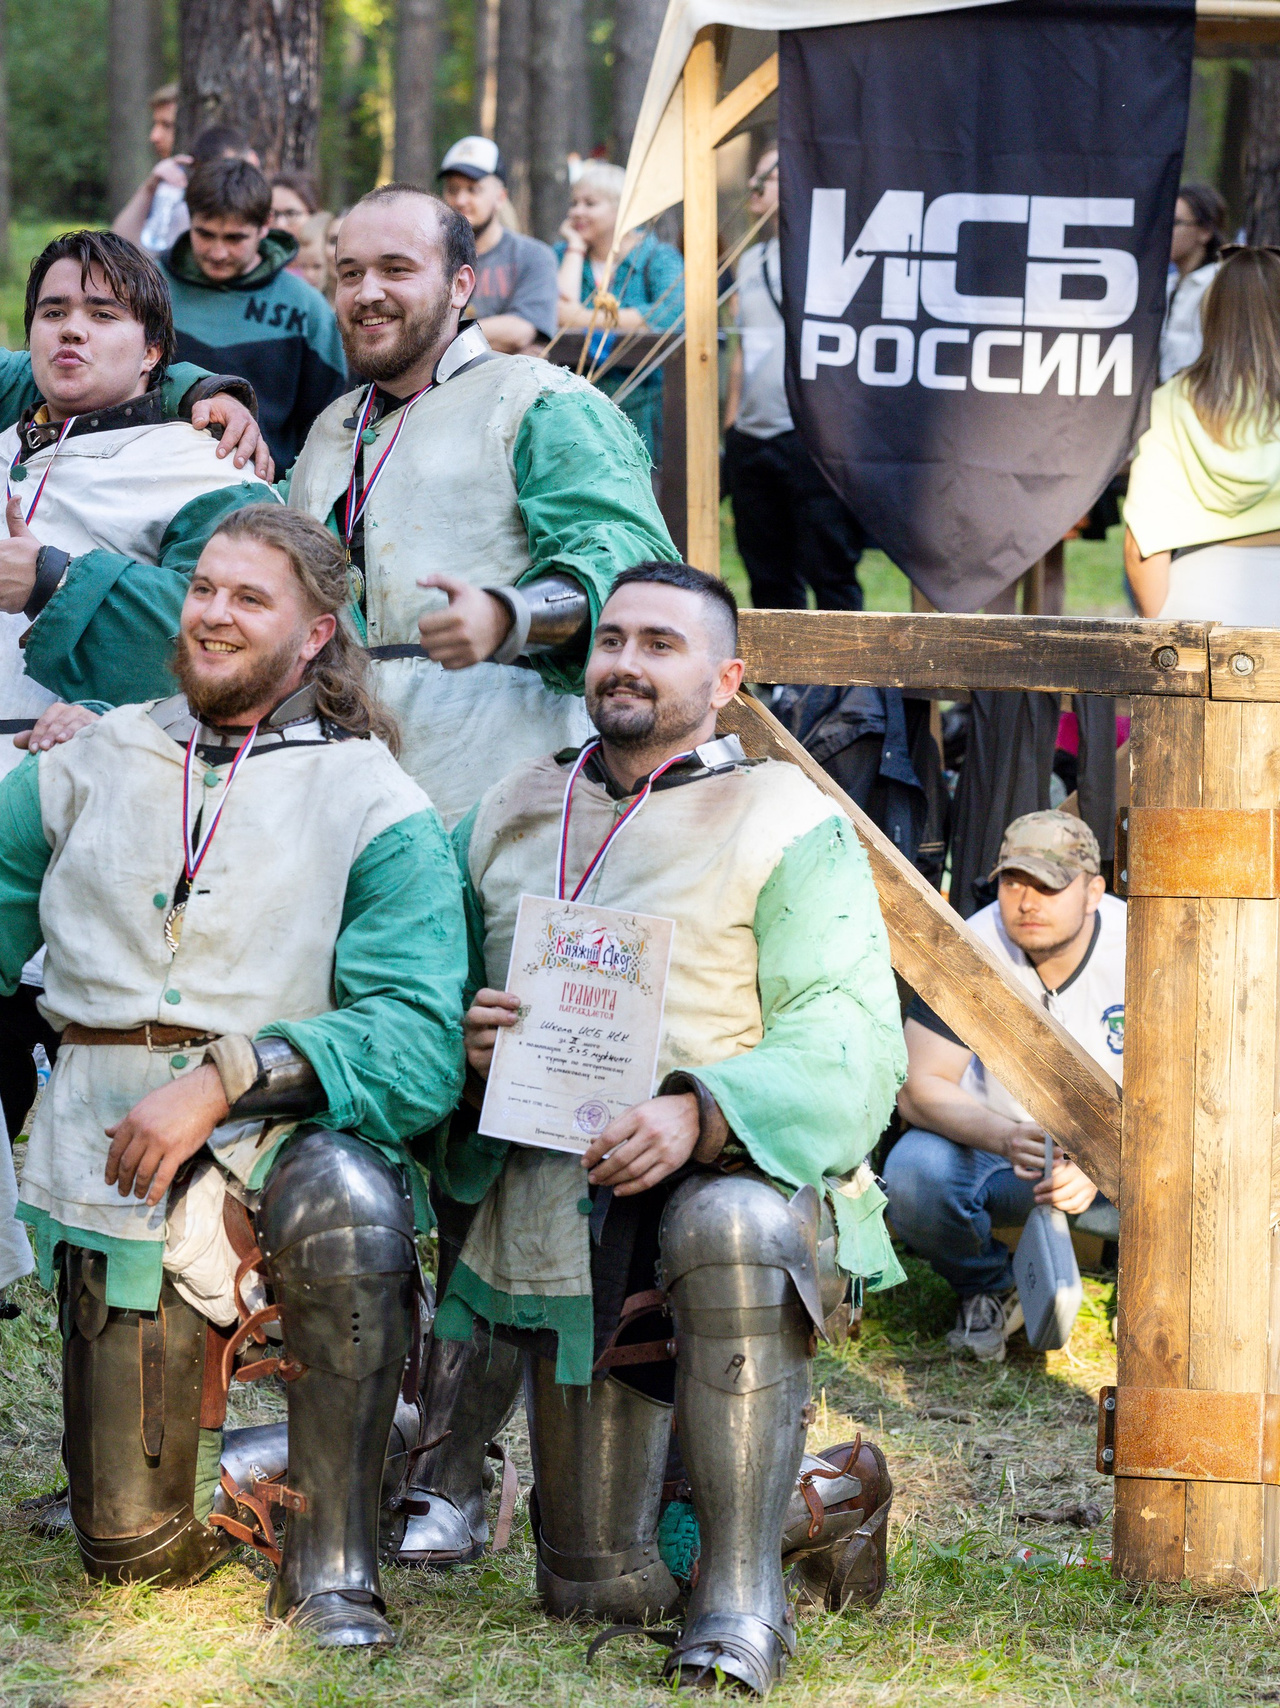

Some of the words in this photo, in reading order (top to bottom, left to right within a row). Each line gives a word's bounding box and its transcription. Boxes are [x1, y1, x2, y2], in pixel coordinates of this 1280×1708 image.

[804, 188, 1139, 329] ИСБ
[244, 297, 307, 334] NSK
[800, 319, 1133, 396] РОССИИ
[561, 981, 617, 1011] ГРАМОТА
